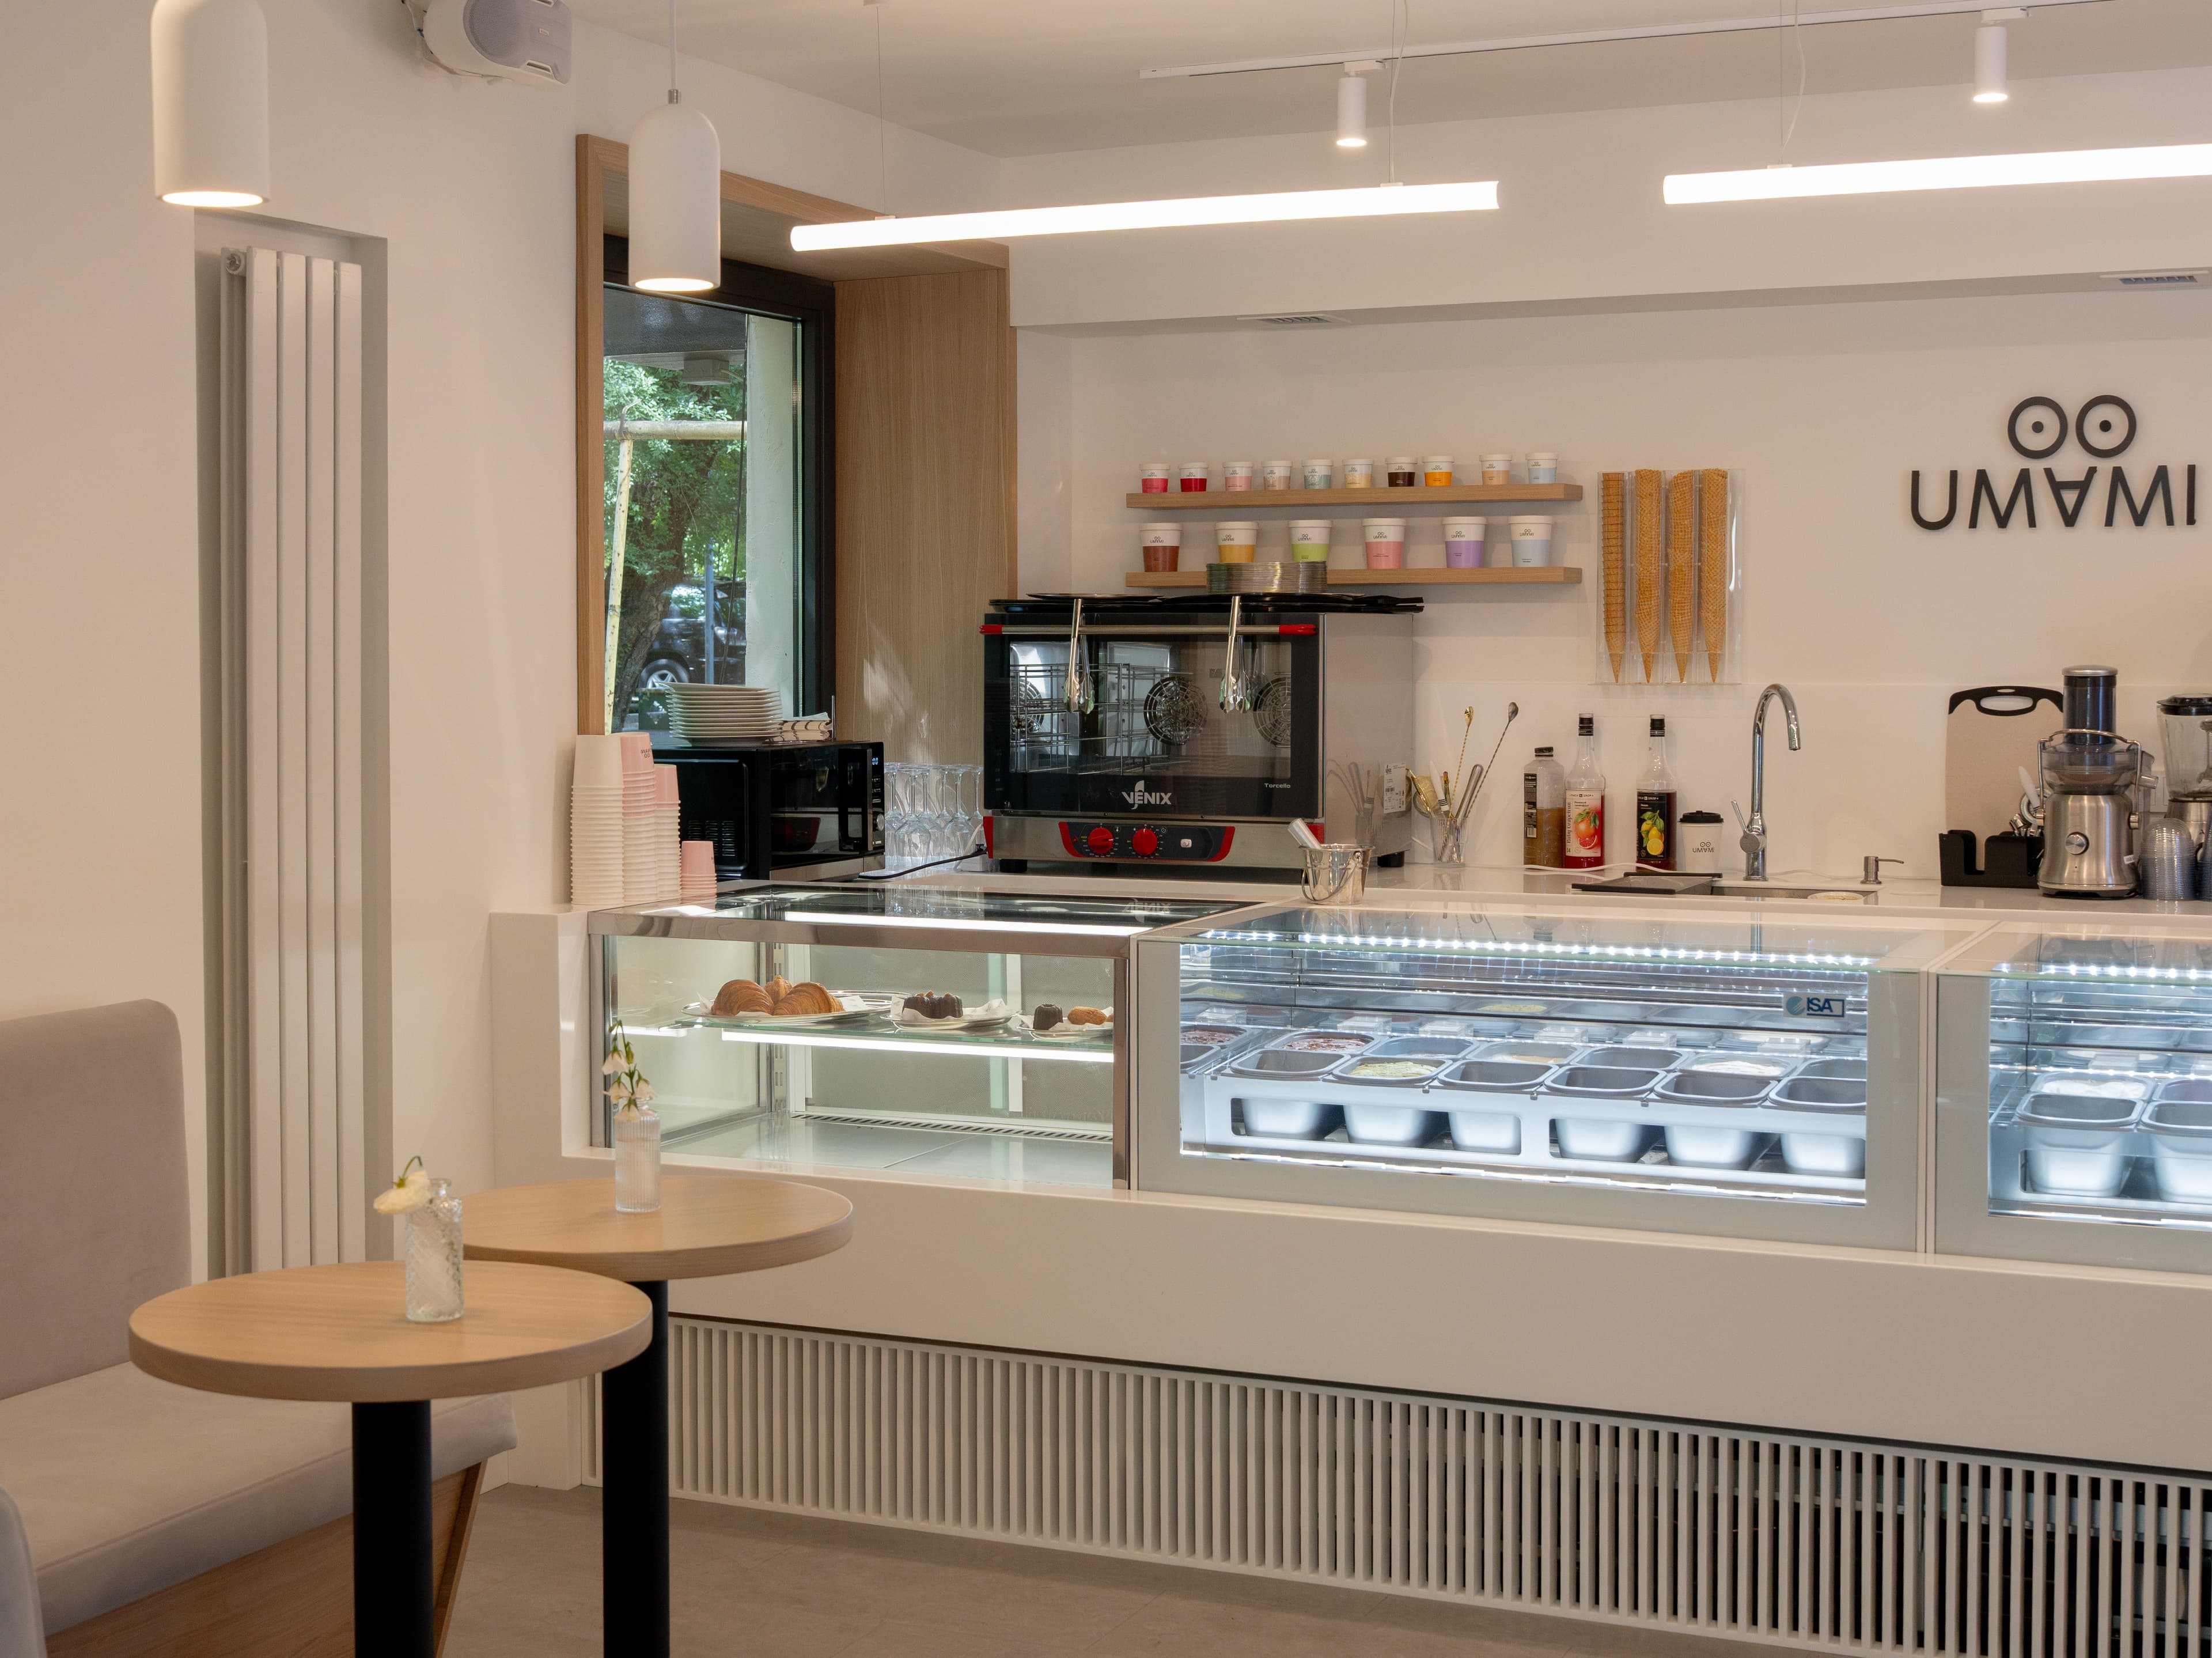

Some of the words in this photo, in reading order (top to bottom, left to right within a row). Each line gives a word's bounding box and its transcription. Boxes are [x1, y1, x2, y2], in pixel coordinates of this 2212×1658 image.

[1911, 464, 2196, 531] UMAMI
[1121, 782, 1172, 809] VENIX
[1806, 997, 1834, 1013] ISA
